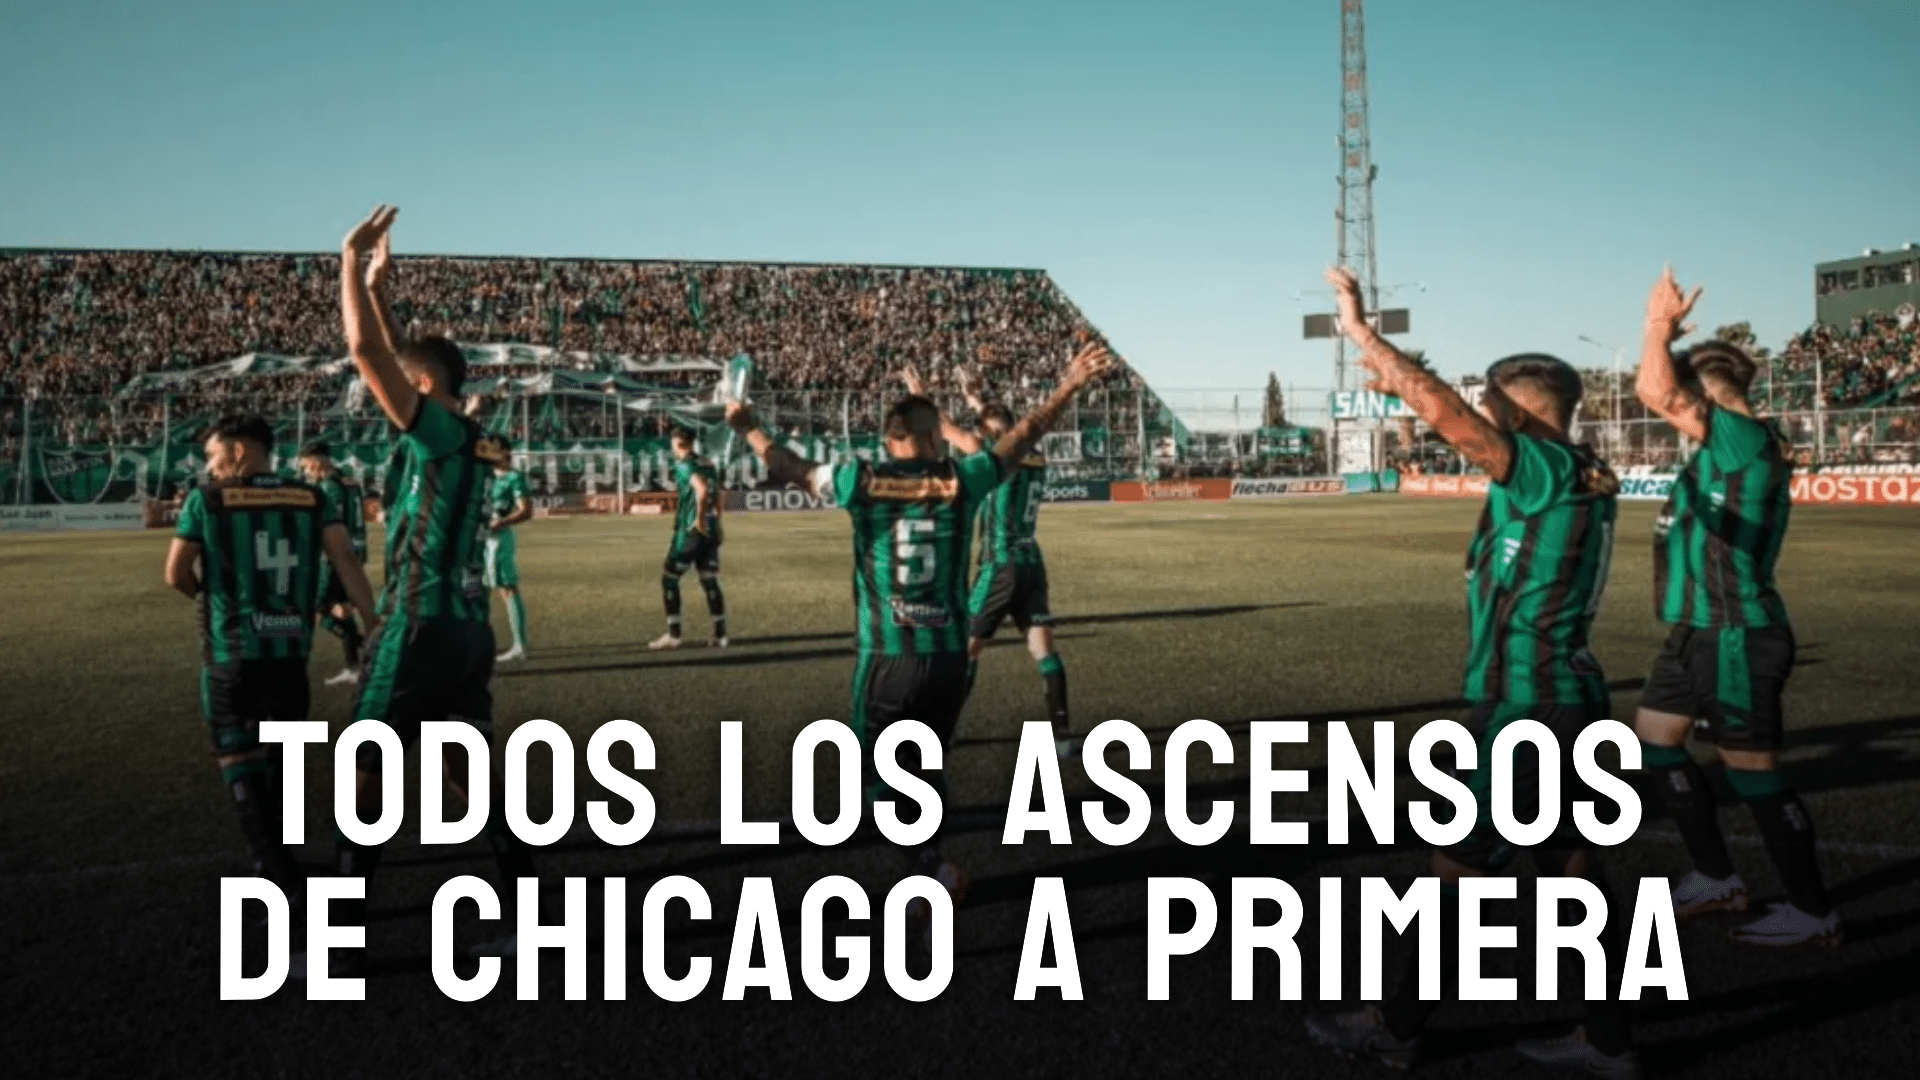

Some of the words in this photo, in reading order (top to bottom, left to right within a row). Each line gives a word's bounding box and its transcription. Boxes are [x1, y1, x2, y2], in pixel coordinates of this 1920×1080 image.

[1334, 391, 1386, 419] SAN
[254, 530, 300, 596] 4
[896, 519, 936, 586] 5
